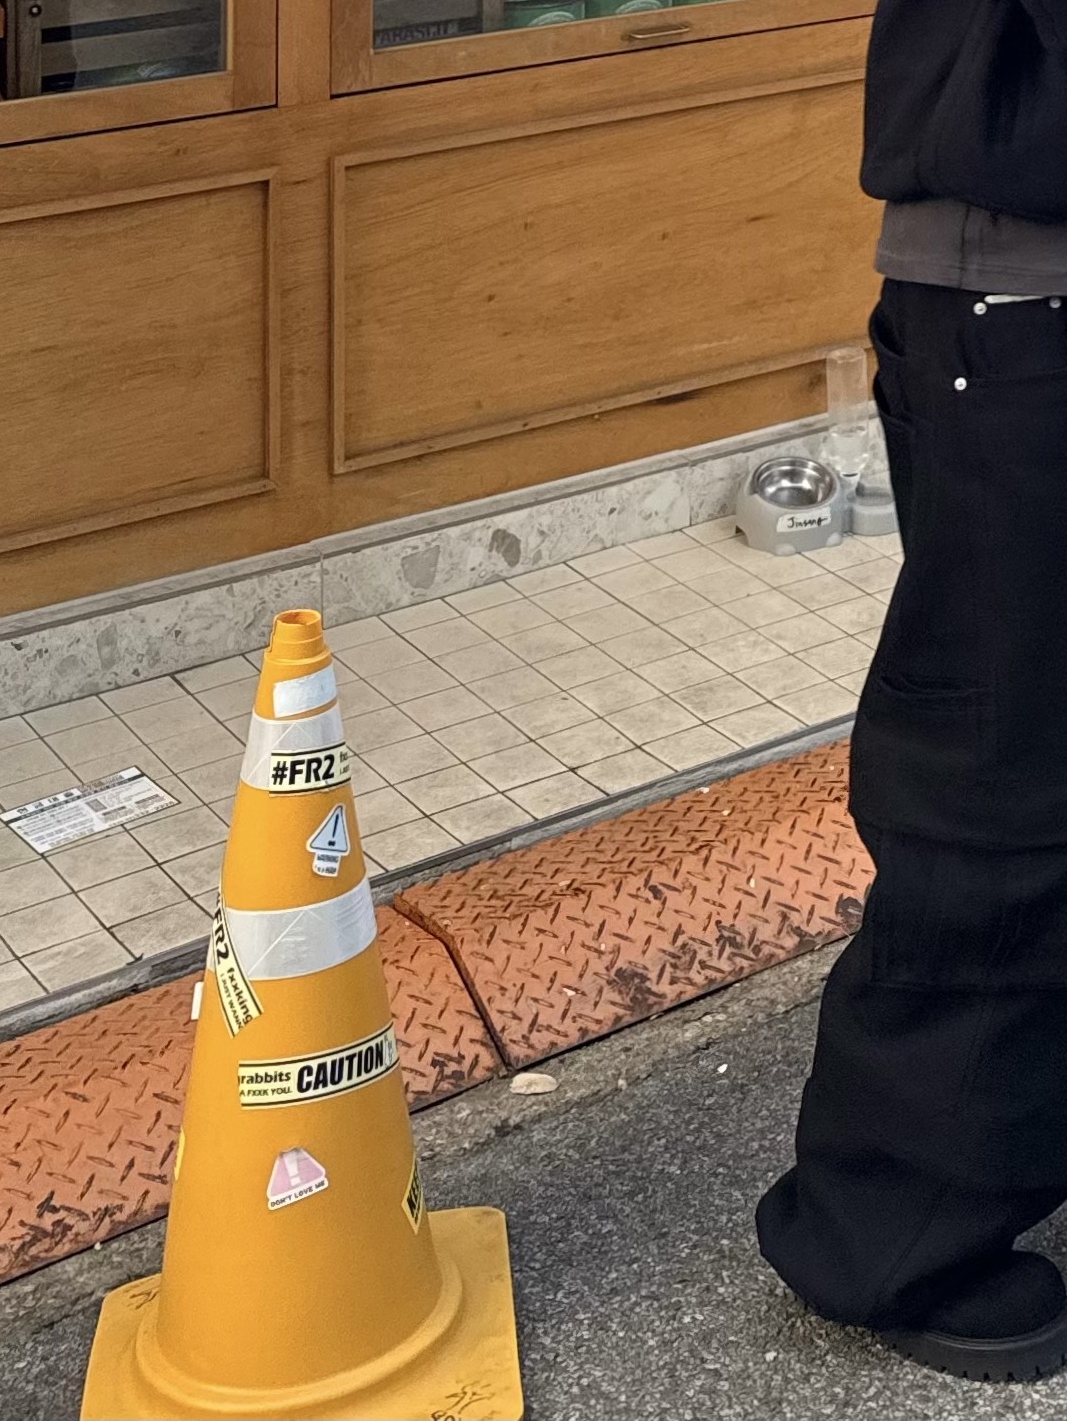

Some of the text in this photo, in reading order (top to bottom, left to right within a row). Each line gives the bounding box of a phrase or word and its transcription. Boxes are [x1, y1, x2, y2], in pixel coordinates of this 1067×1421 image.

[271, 753, 335, 785] #FR2
[227, 967, 253, 1025] fxxking
[240, 1039, 384, 1093] rabbits CAUTION
[294, 1186, 314, 1200] LOVE
